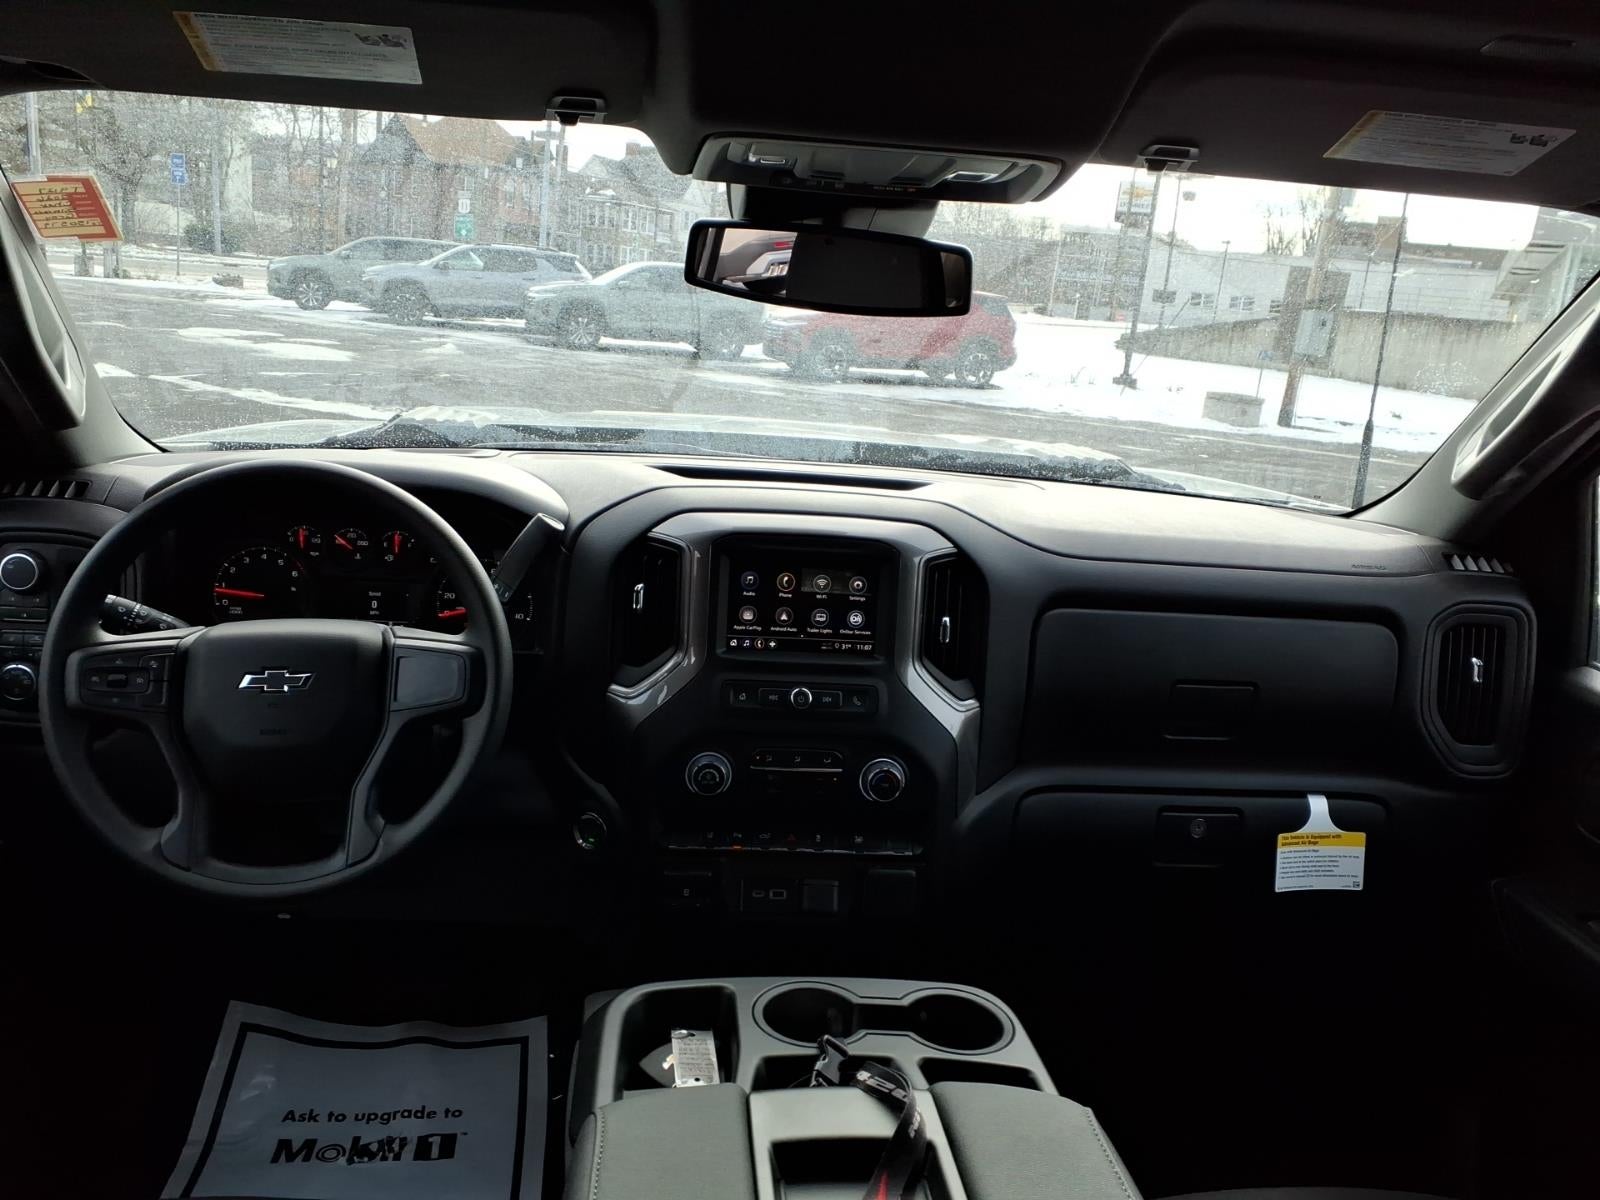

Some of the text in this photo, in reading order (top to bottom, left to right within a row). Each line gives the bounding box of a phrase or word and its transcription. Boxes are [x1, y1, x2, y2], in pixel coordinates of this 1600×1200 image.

[371, 600, 378, 609] 0
[281, 1105, 464, 1126] Ask to upgrade to
